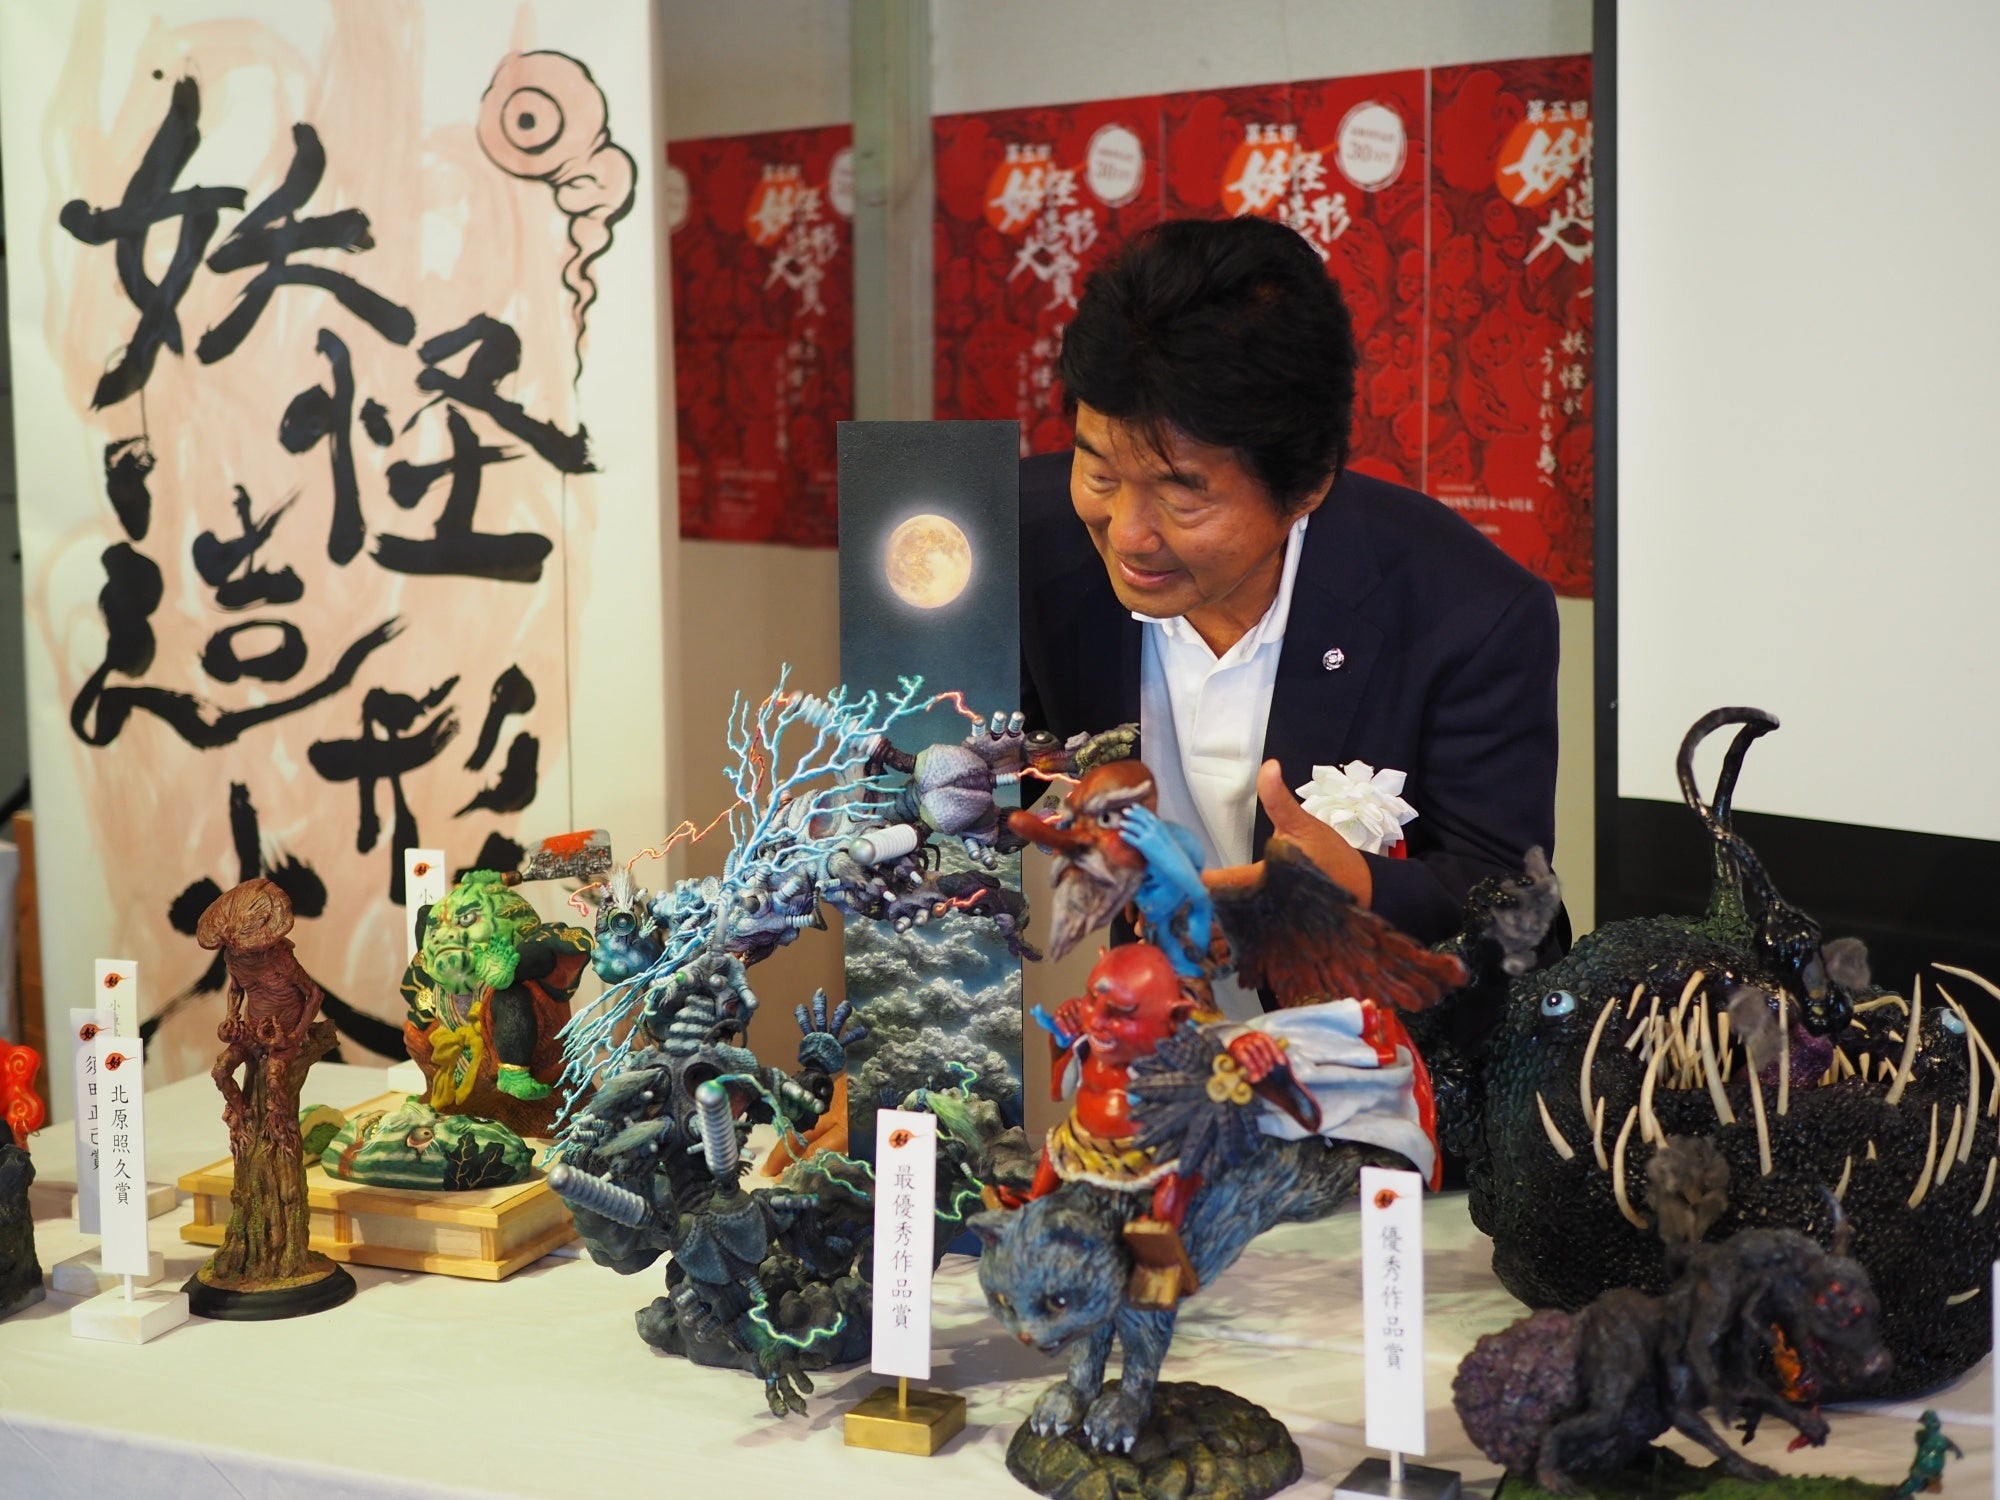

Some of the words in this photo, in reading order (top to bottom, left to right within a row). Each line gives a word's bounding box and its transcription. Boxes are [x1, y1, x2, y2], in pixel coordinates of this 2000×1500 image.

[110, 1084, 131, 1206] 北原照久賞
[891, 1164, 915, 1330] 最優秀作品賞
[1381, 1225, 1404, 1370] 優秀作品賞
